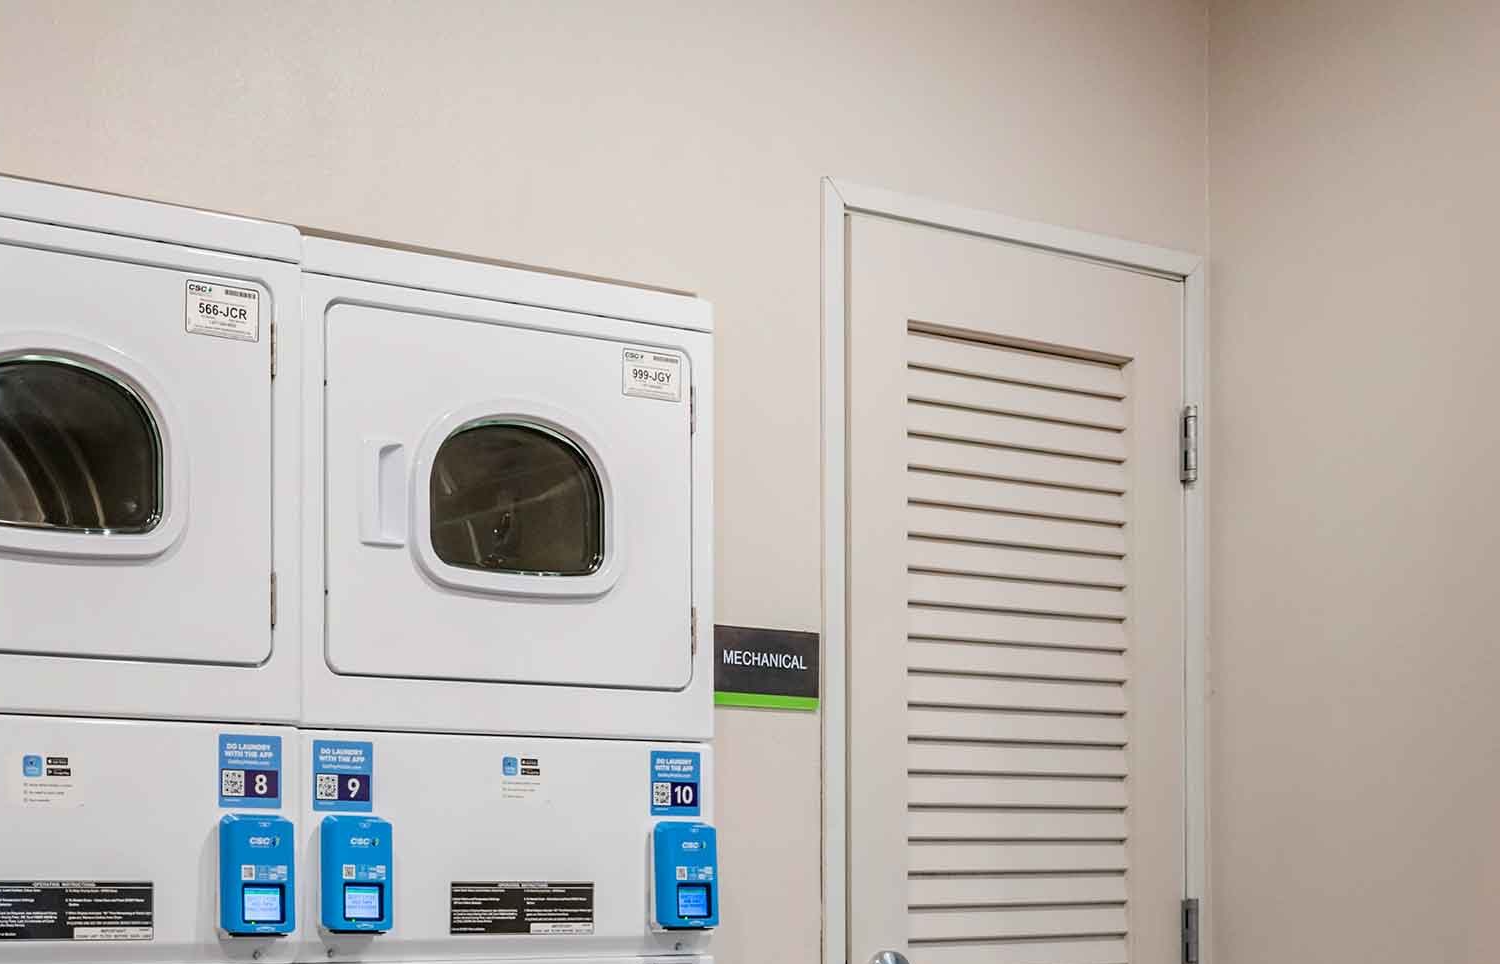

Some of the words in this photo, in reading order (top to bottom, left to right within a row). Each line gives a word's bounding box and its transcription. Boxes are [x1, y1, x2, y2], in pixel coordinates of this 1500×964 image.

[188, 284, 208, 293] CSC
[198, 302, 247, 320] 566-JCR
[632, 368, 672, 383] 999-JGY
[722, 649, 808, 670] MECHANICAL
[254, 774, 268, 795] 8
[348, 778, 360, 798] 9
[674, 786, 694, 804] 10
[250, 836, 270, 846] CSC
[350, 837, 370, 846] CSC
